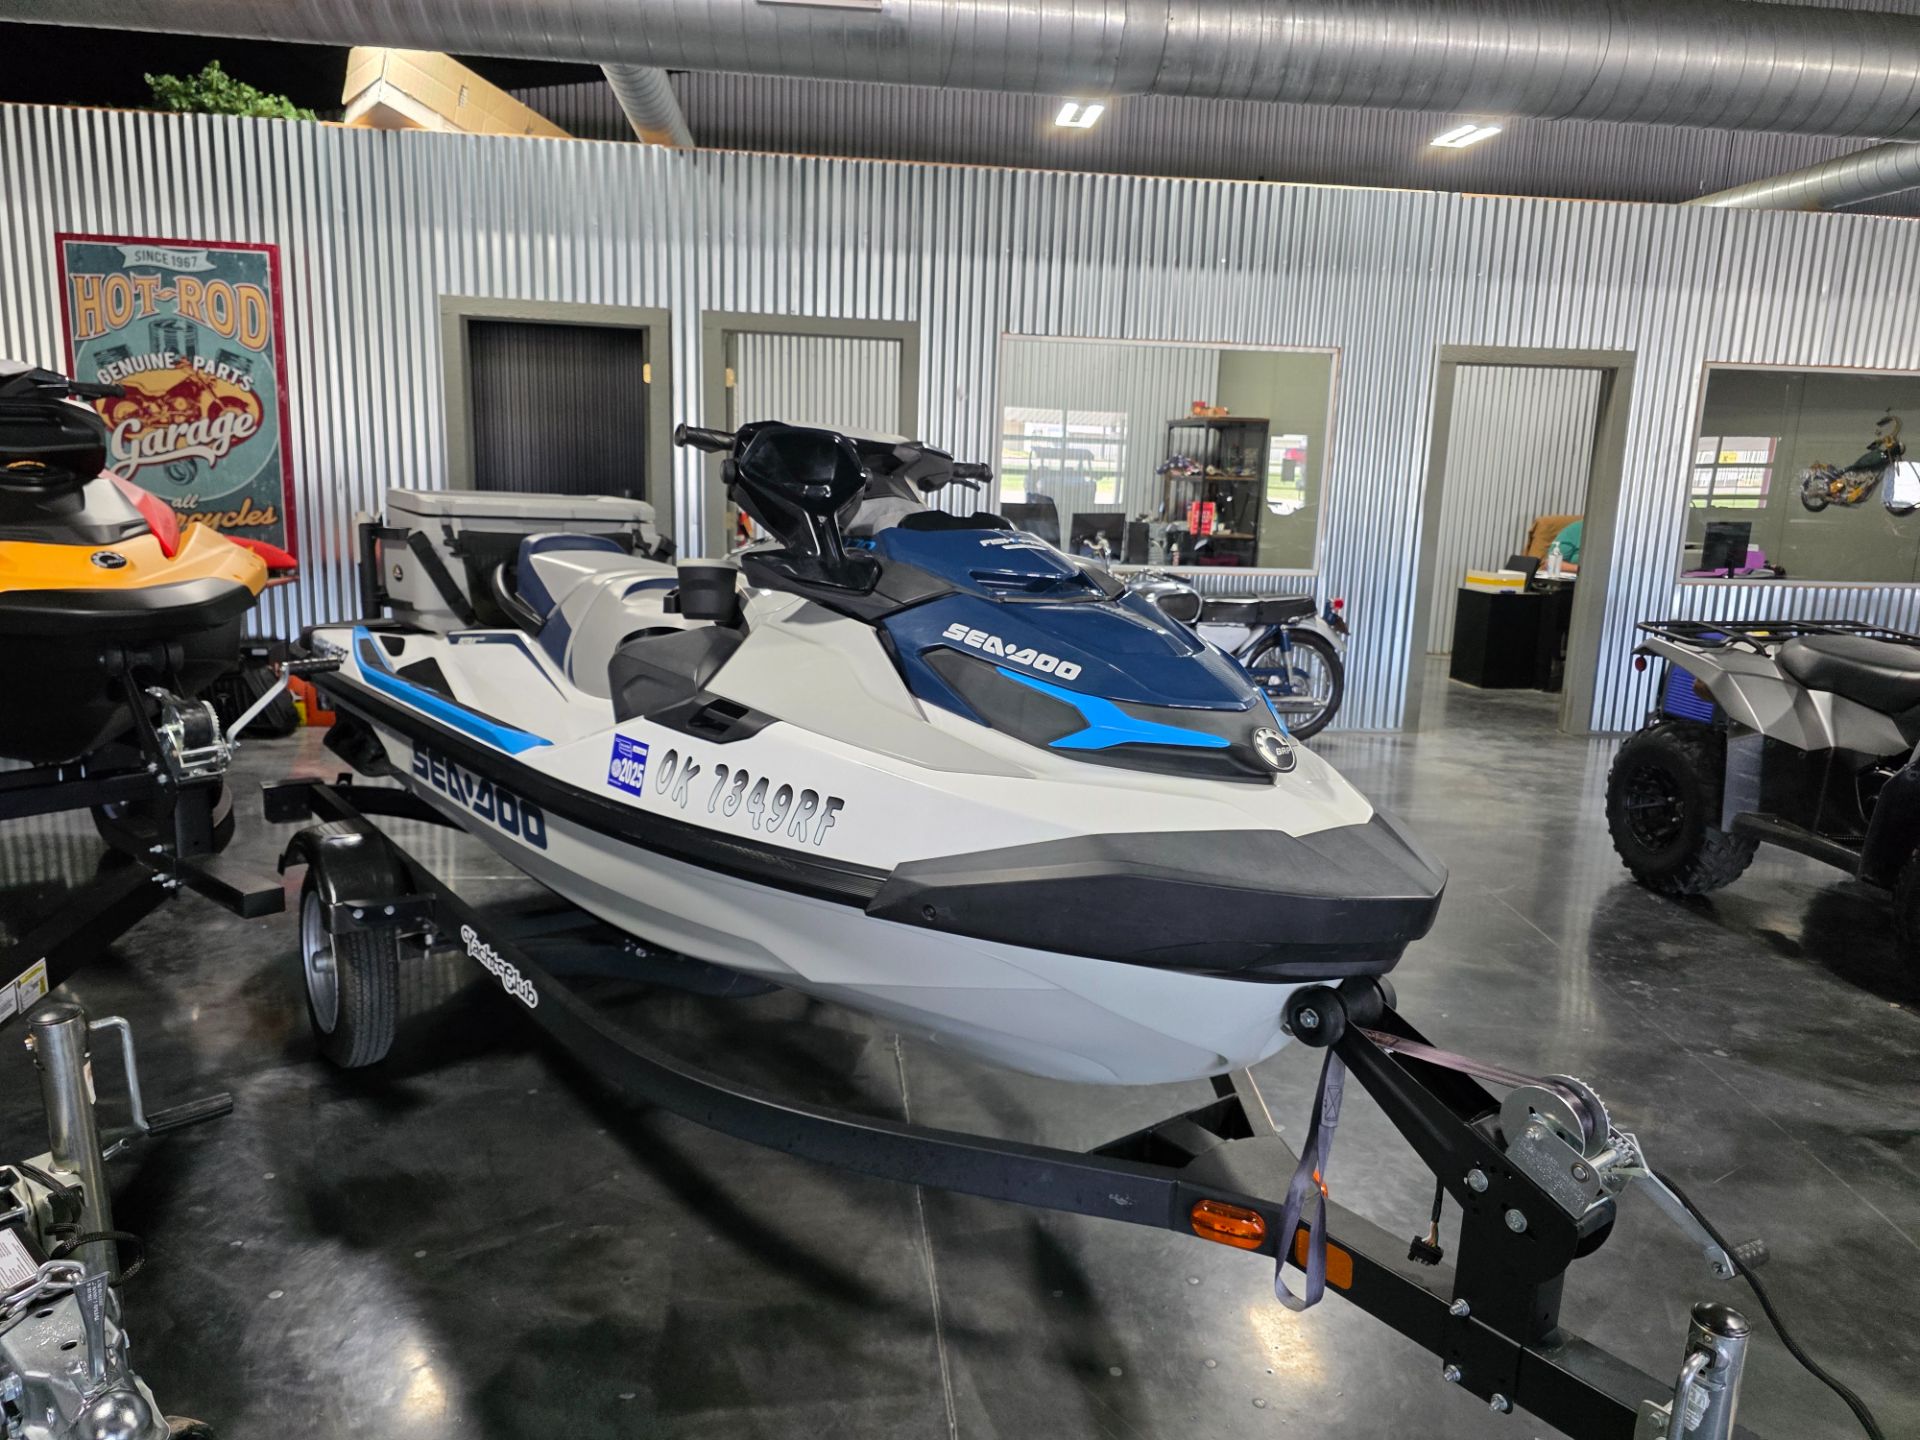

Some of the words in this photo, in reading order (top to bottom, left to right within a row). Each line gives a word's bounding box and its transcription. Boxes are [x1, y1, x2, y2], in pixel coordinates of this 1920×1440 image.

[134, 250, 169, 265] SINCE
[171, 254, 198, 268] 1967
[97, 352, 176, 385] GENUINE
[193, 355, 254, 392] PARTS
[109, 411, 258, 480] Garage
[171, 493, 199, 509] all
[618, 757, 645, 789] 2025
[655, 748, 701, 810] OK
[707, 762, 845, 846] 7349RF
